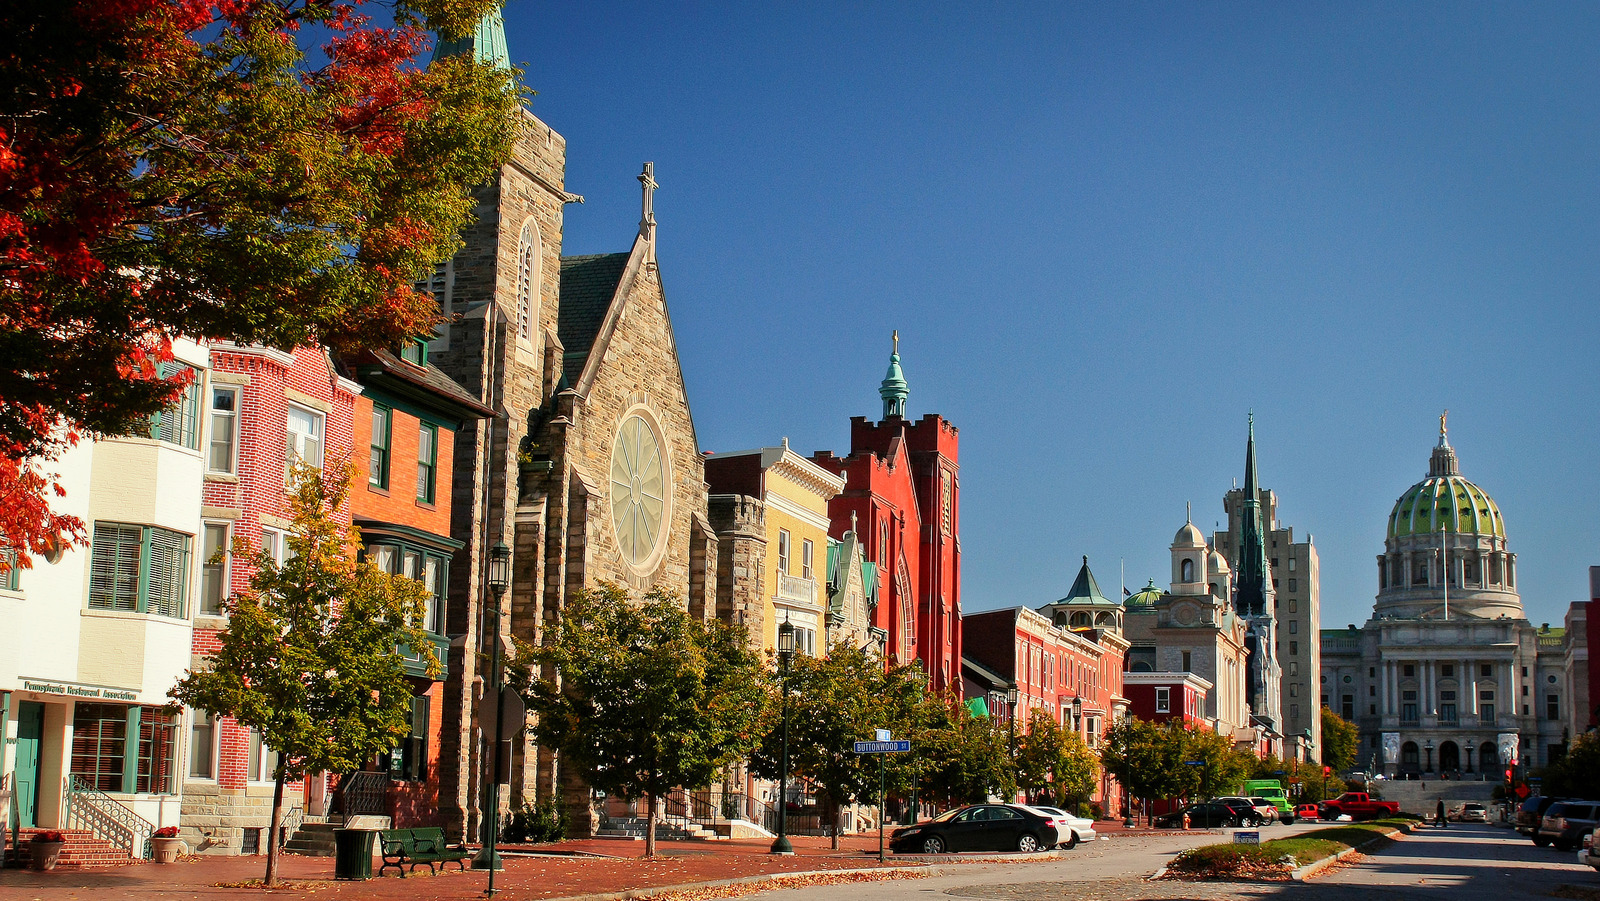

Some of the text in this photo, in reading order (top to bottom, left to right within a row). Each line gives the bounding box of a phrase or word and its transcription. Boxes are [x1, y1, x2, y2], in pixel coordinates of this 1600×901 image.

[24, 681, 137, 700] Pennsylvania Restaurant Association
[857, 743, 898, 752] BUTTONWOOD
